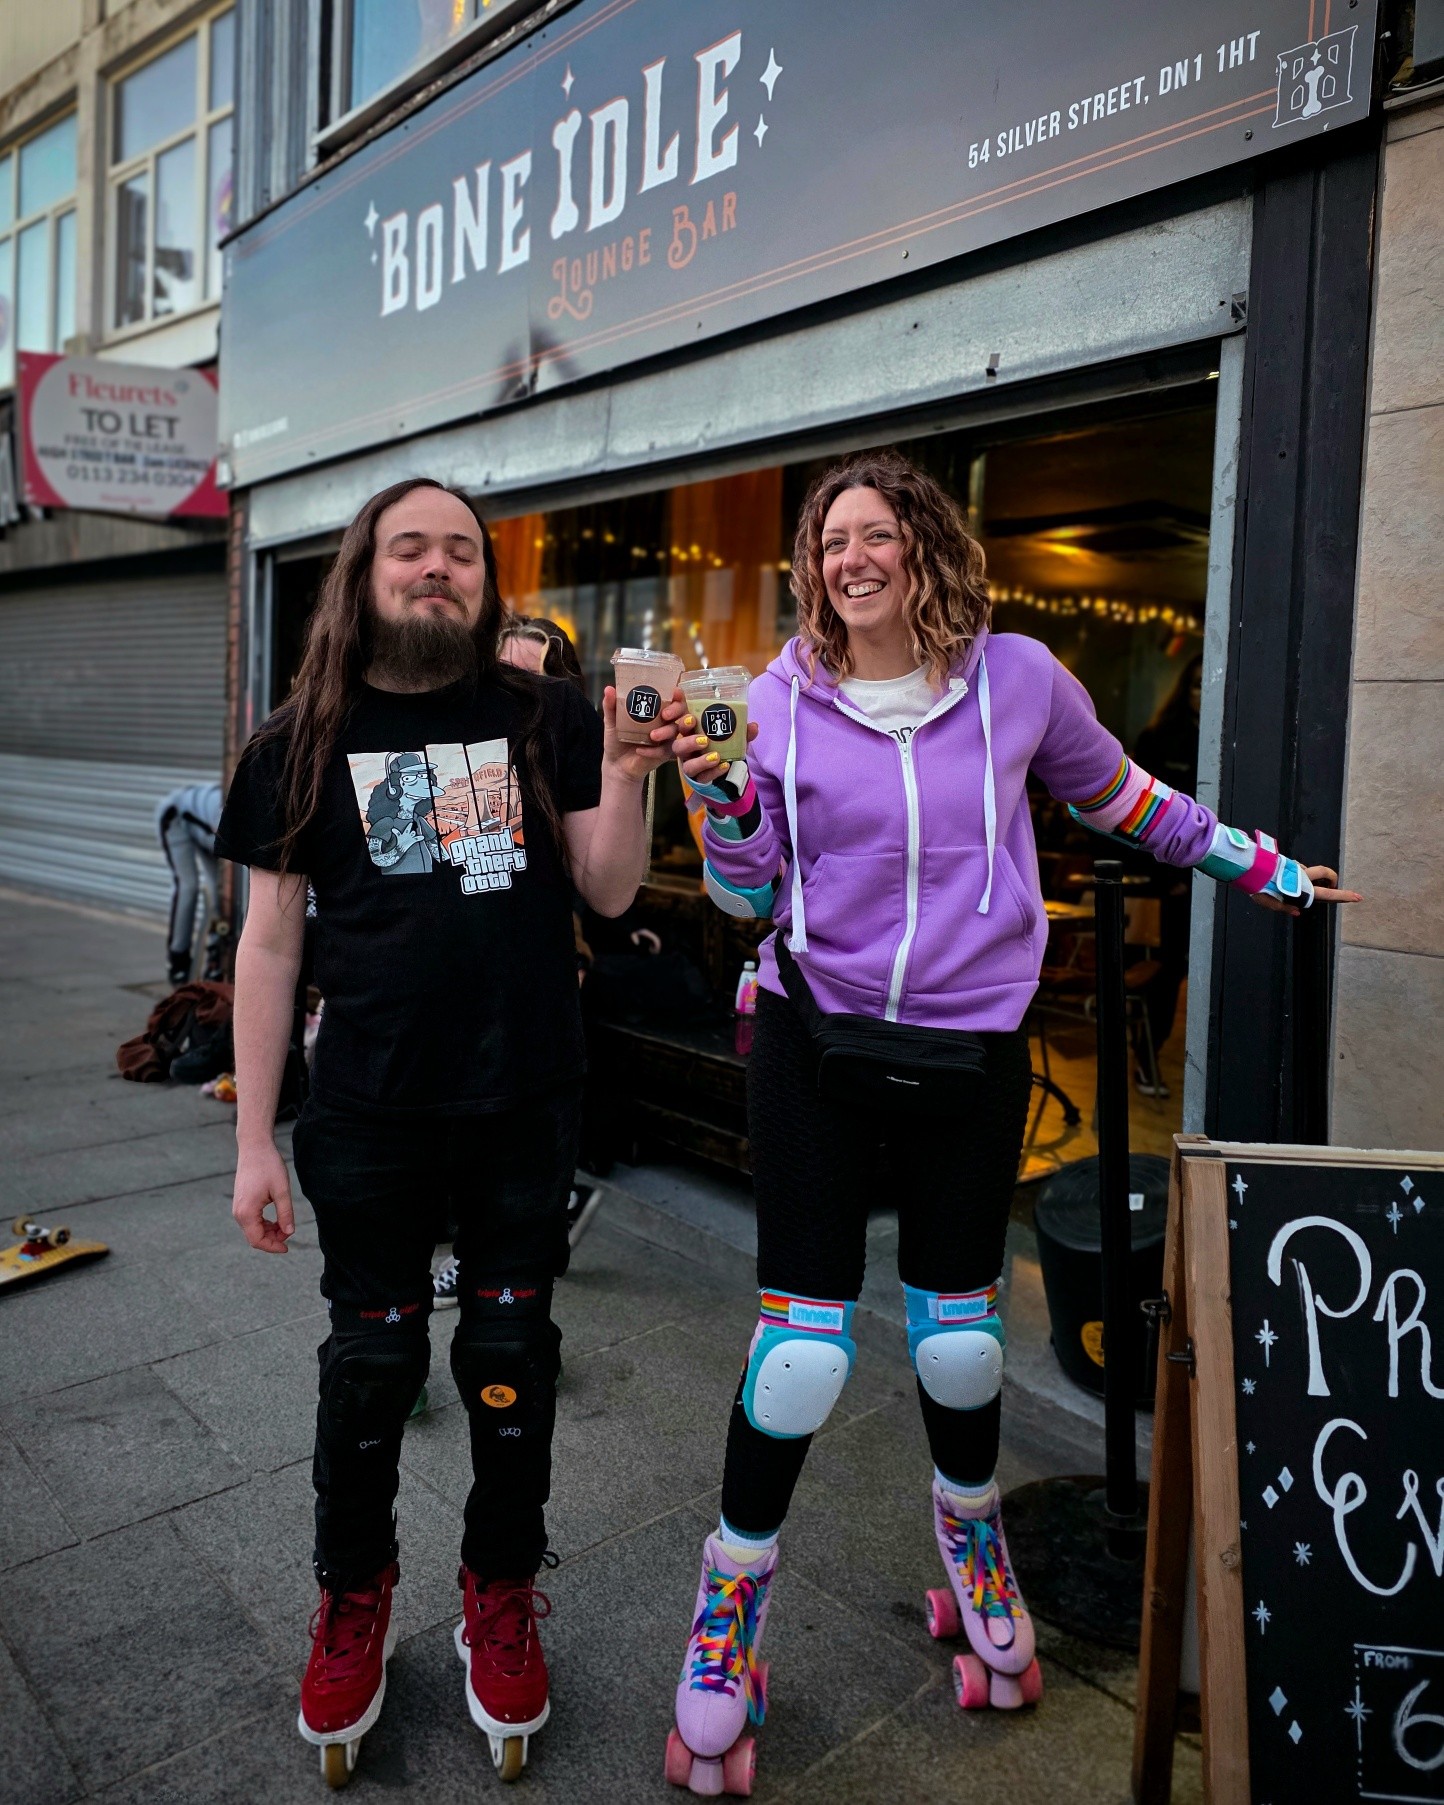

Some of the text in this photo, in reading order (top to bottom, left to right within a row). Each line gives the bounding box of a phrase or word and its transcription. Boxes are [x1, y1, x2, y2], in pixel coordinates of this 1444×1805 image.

[968, 30, 1261, 170] 54 SILVER STREET, DN1 1HT
[380, 29, 742, 318] BONE IDLE
[68, 372, 178, 407] Fleurets
[79, 407, 180, 440] TO LET
[66, 464, 113, 482] 0113
[1364, 1651, 1409, 1669] FROM
